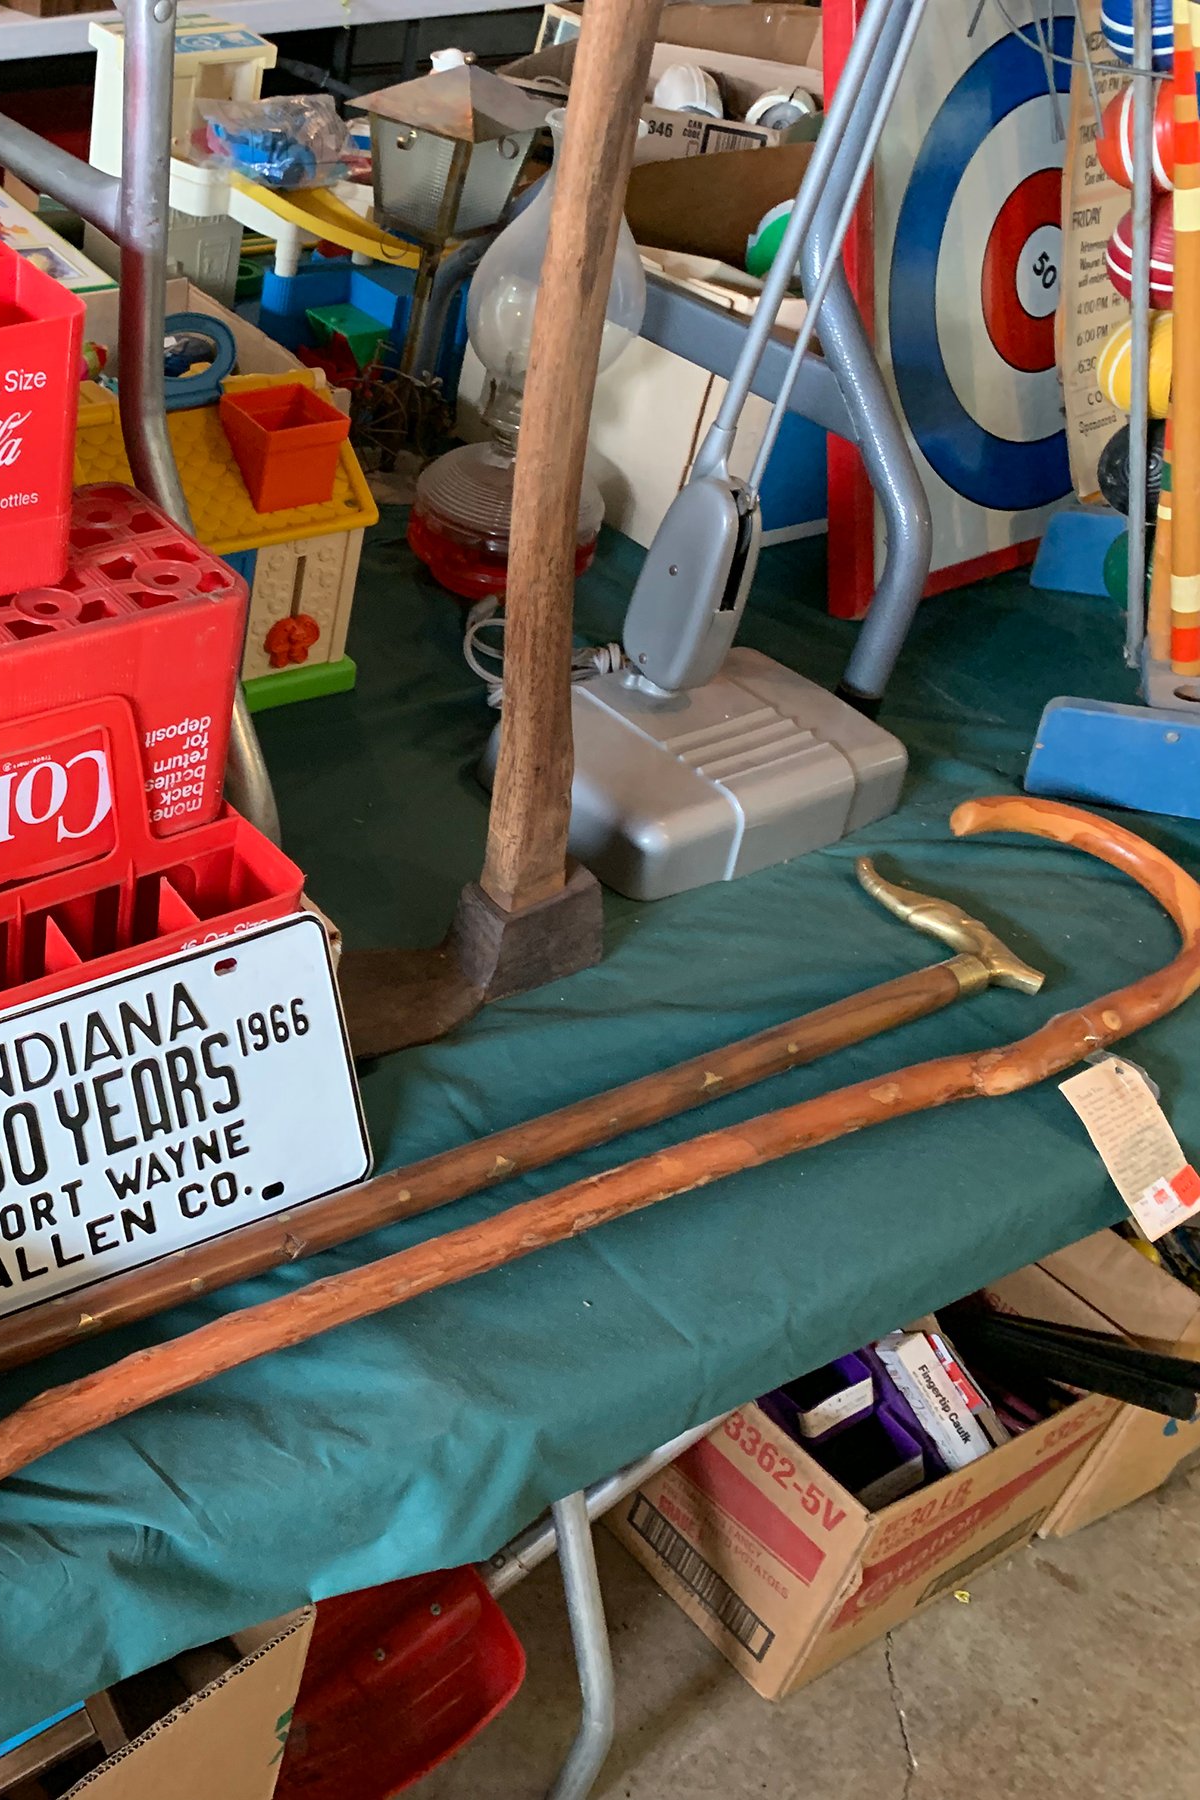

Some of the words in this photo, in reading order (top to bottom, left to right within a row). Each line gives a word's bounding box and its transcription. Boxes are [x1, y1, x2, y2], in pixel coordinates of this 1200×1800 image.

[1072, 206, 1101, 231] FRIDAY
[1032, 251, 1057, 289] 50
[4, 368, 47, 393] Size
[144, 715, 212, 748] deposit
[182, 731, 209, 750] for
[153, 747, 209, 774] return
[160, 781, 204, 806] back
[52, 1030, 244, 1167] YEARS
[235, 997, 311, 1058] 1966
[104, 1119, 251, 1201] WAYNE
[178, 1171, 254, 1220] CO.
[918, 1364, 951, 1414] Fingertip
[948, 1412, 972, 1444] Caulk
[722, 1410, 848, 1532] 3362-5V
